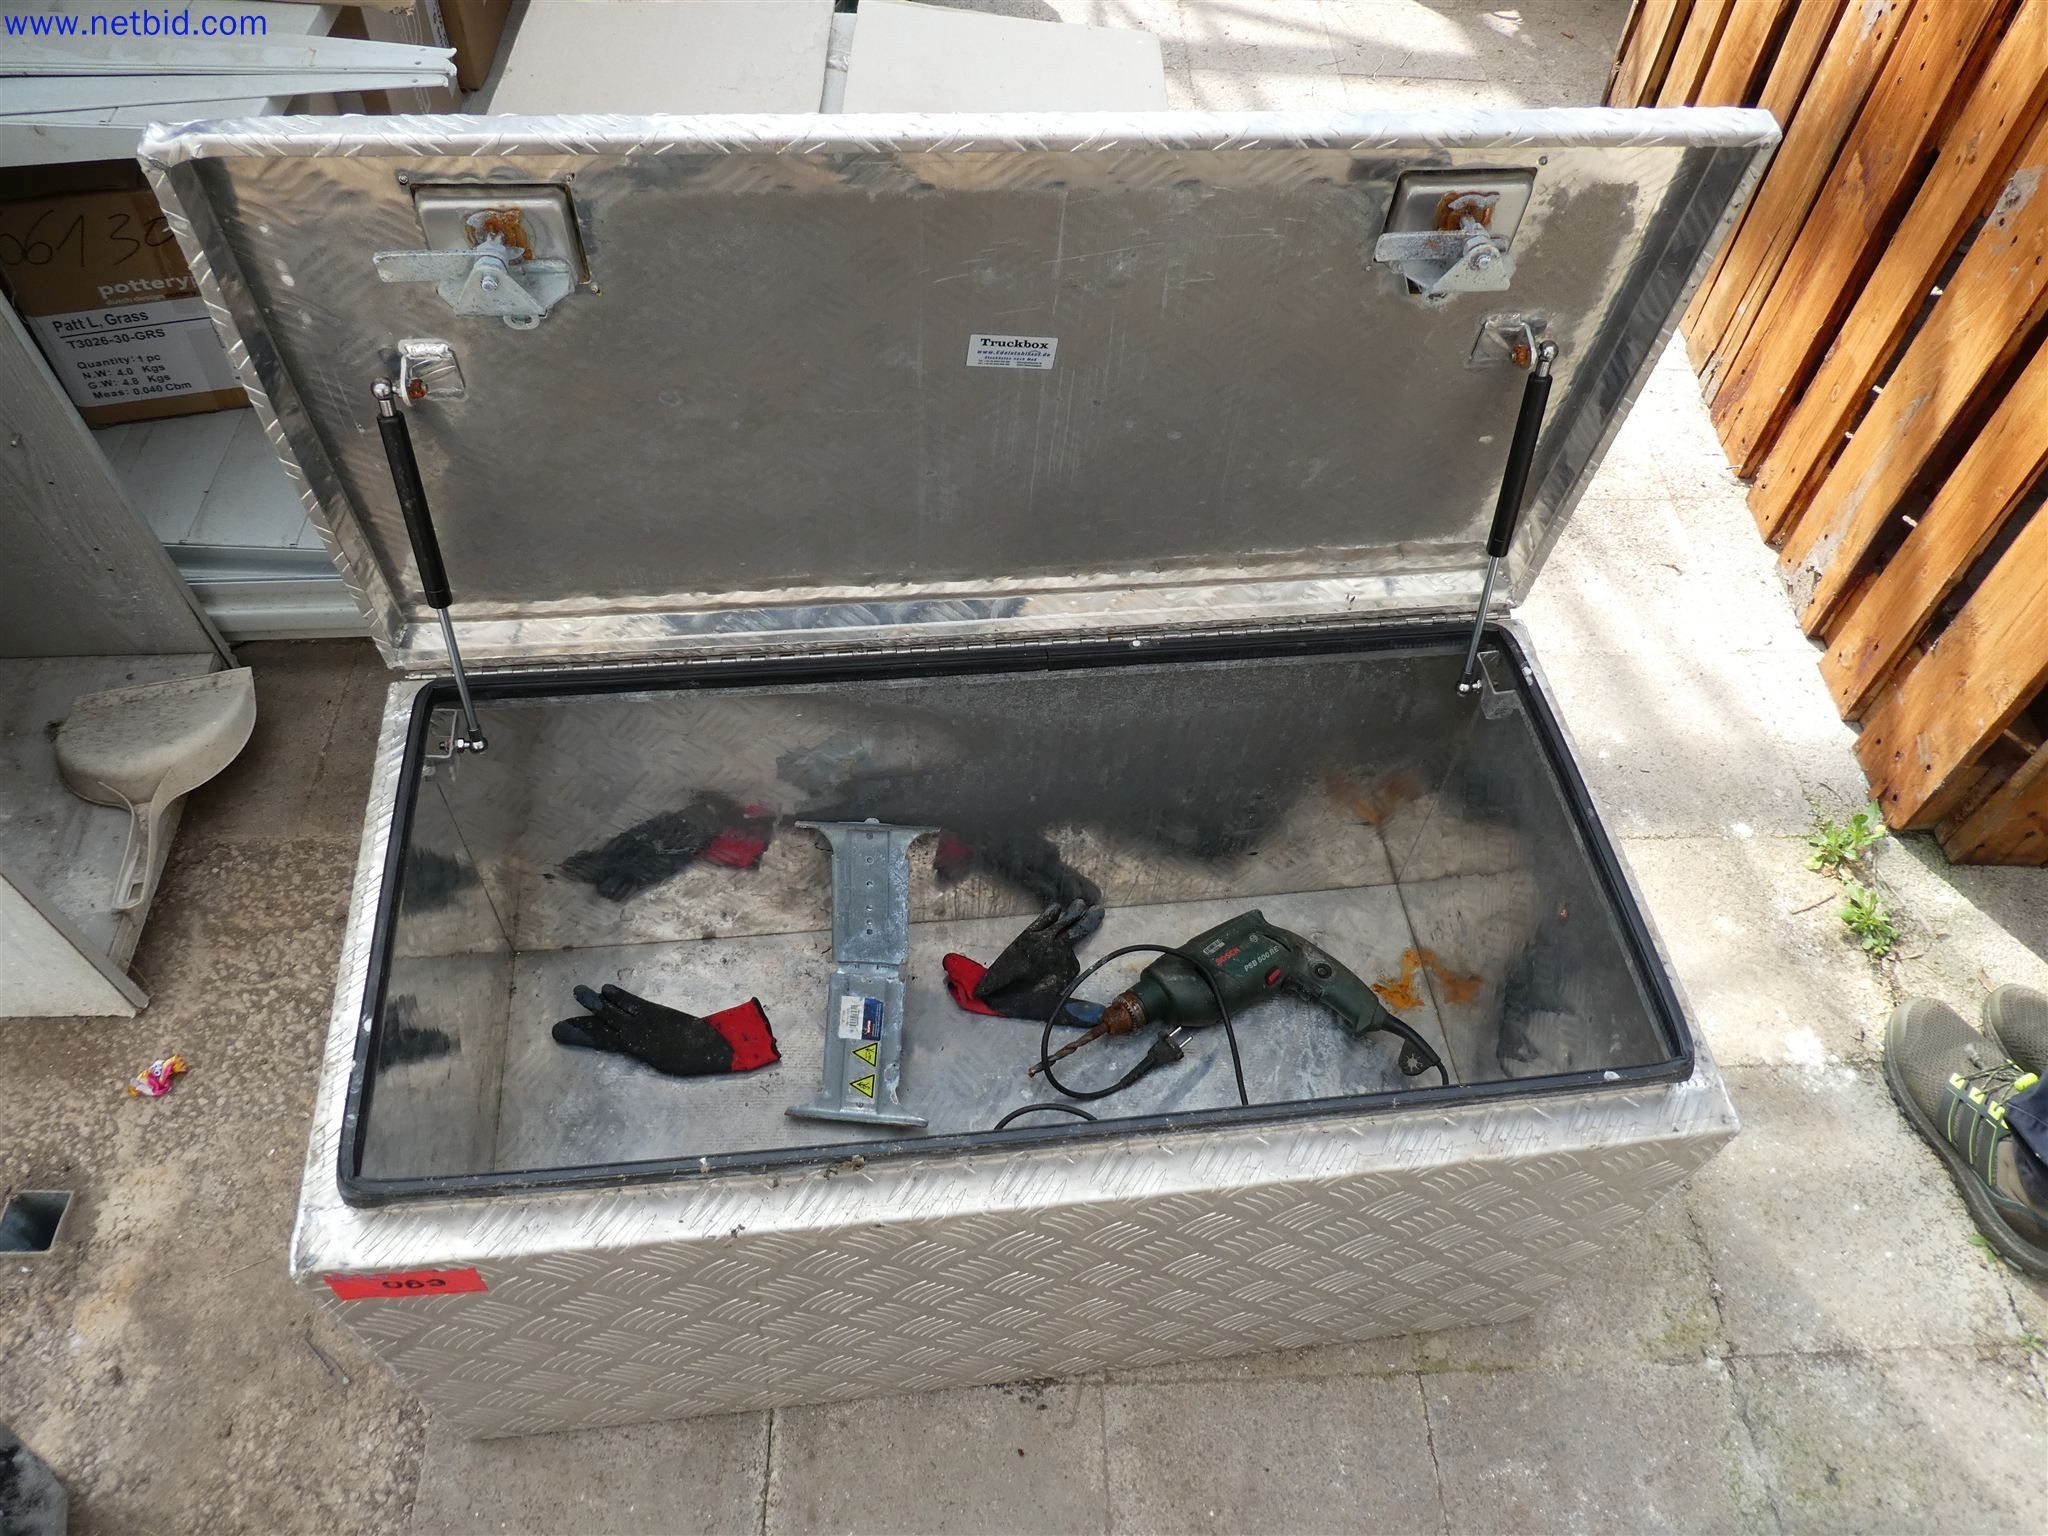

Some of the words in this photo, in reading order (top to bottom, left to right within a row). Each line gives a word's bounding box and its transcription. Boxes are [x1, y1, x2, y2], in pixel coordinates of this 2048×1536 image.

[51, 316, 85, 333] Patt
[104, 310, 149, 326] Grass
[66, 328, 166, 350] T3026-30-GRS
[980, 338, 1049, 349] Truckbox
[146, 353, 161, 364] pc
[116, 367, 134, 377] 4.0
[142, 363, 166, 374] Kgs
[147, 373, 172, 384] Kgs
[93, 388, 130, 400] Meas:
[133, 385, 163, 396] 0.040
[166, 381, 192, 392] Cbm
[1216, 947, 1241, 965] BOSCH
